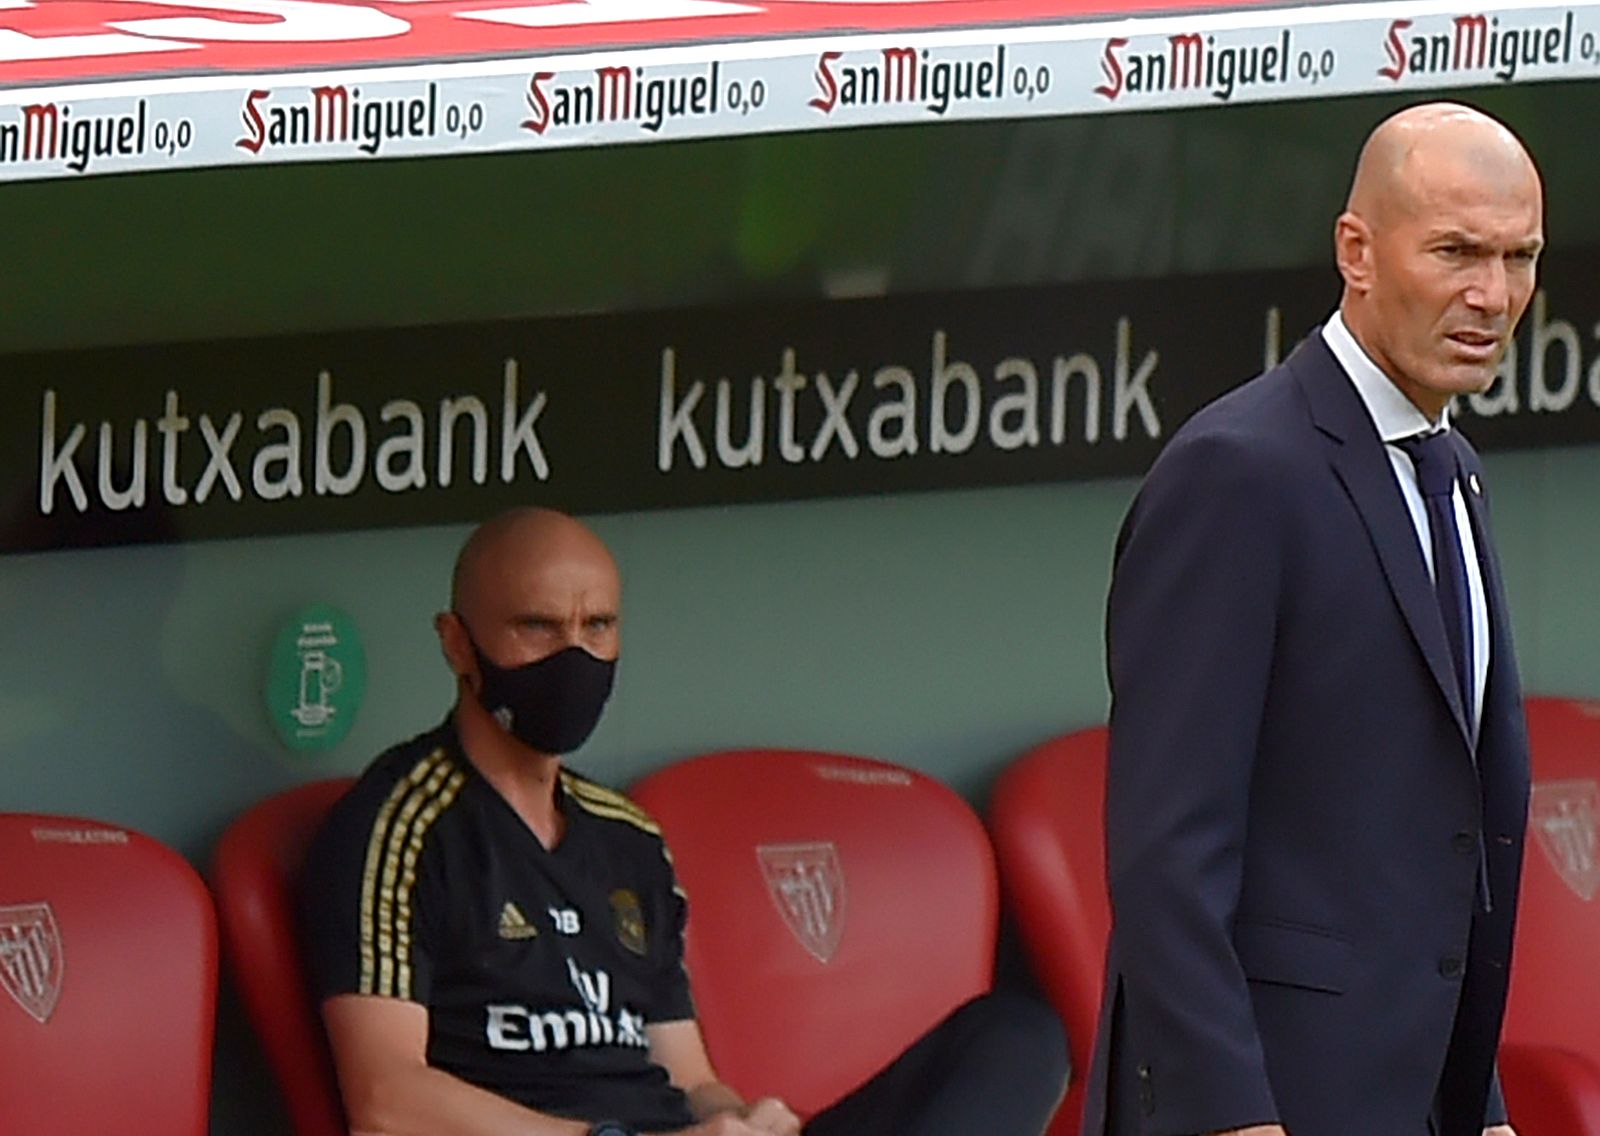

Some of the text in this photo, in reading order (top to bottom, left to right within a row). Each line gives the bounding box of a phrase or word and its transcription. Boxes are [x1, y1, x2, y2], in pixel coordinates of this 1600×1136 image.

[808, 44, 1006, 115] SanMiguel
[1093, 30, 1291, 101] SanMiguel
[1377, 12, 1574, 81] SanMiguel
[235, 83, 437, 155] SanMiguel
[521, 61, 720, 135] SanMiguel
[656, 315, 1162, 473] kutxabank
[39, 357, 550, 515] kutxabank
